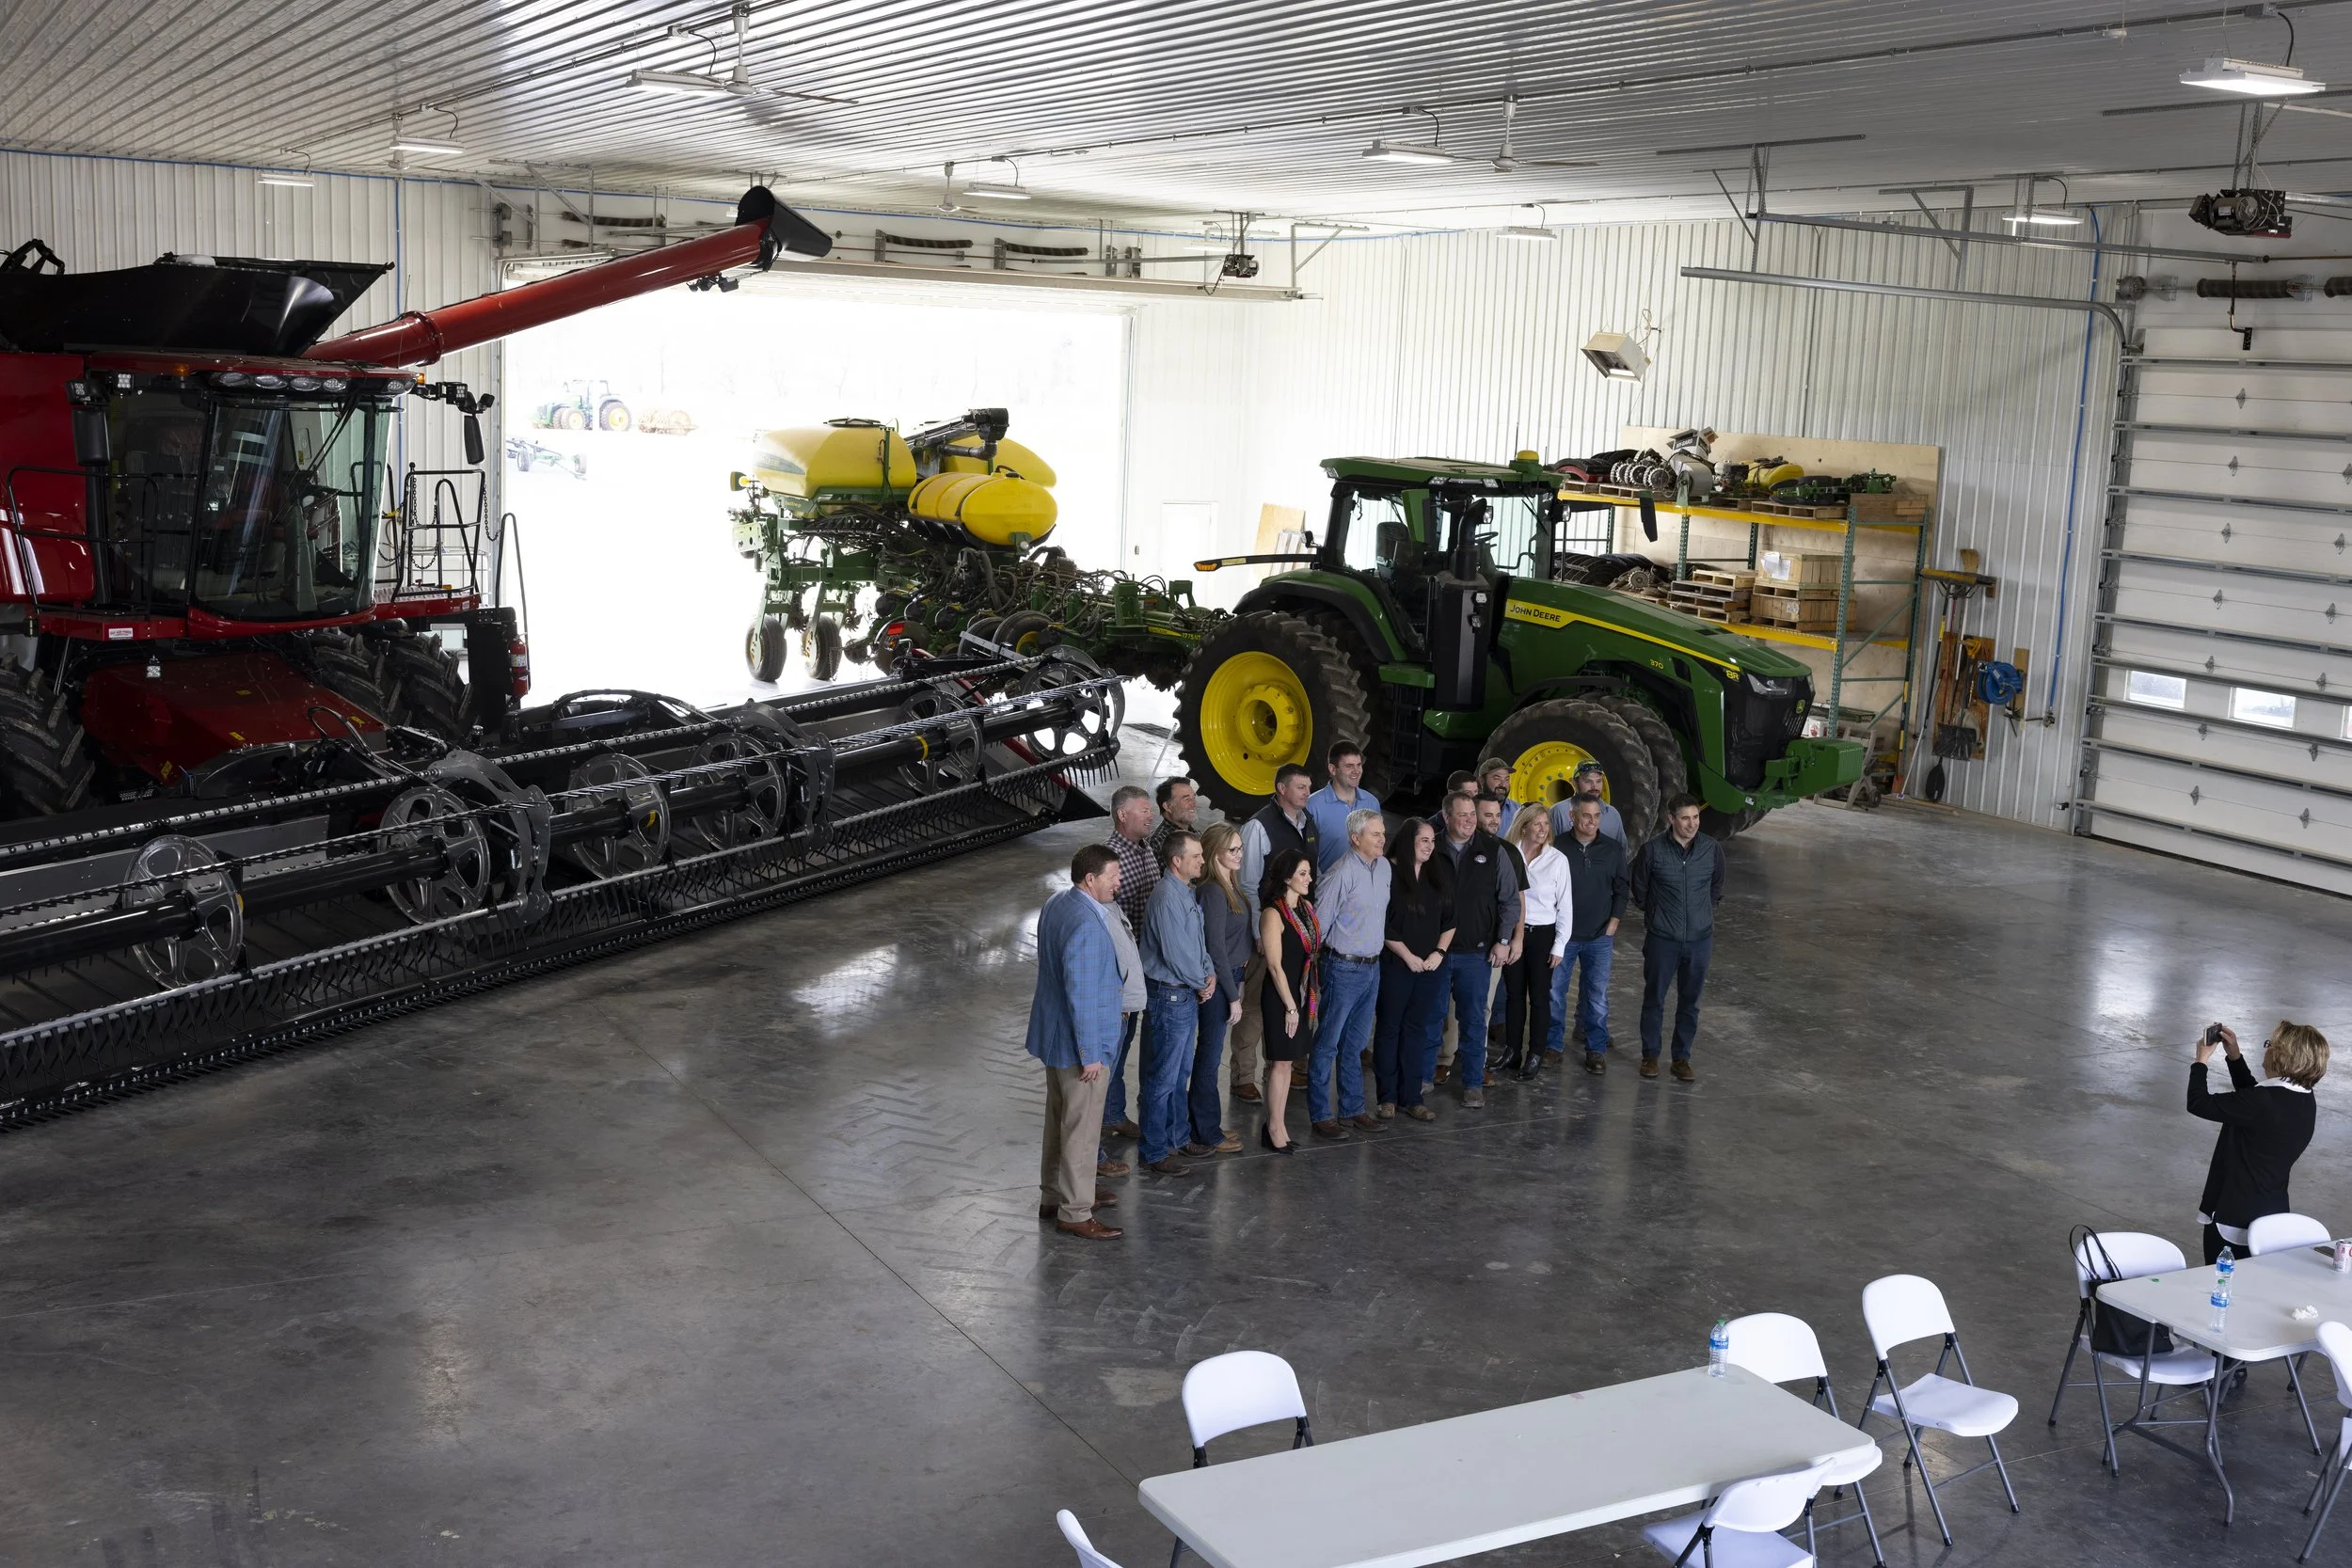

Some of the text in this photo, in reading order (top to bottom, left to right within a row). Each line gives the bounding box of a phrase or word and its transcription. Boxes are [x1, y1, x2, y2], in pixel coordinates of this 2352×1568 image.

[1510, 605, 1561, 623] JOHN DEERE
[1649, 658, 1664, 669] 370
[1725, 670, 1740, 680] 8R
